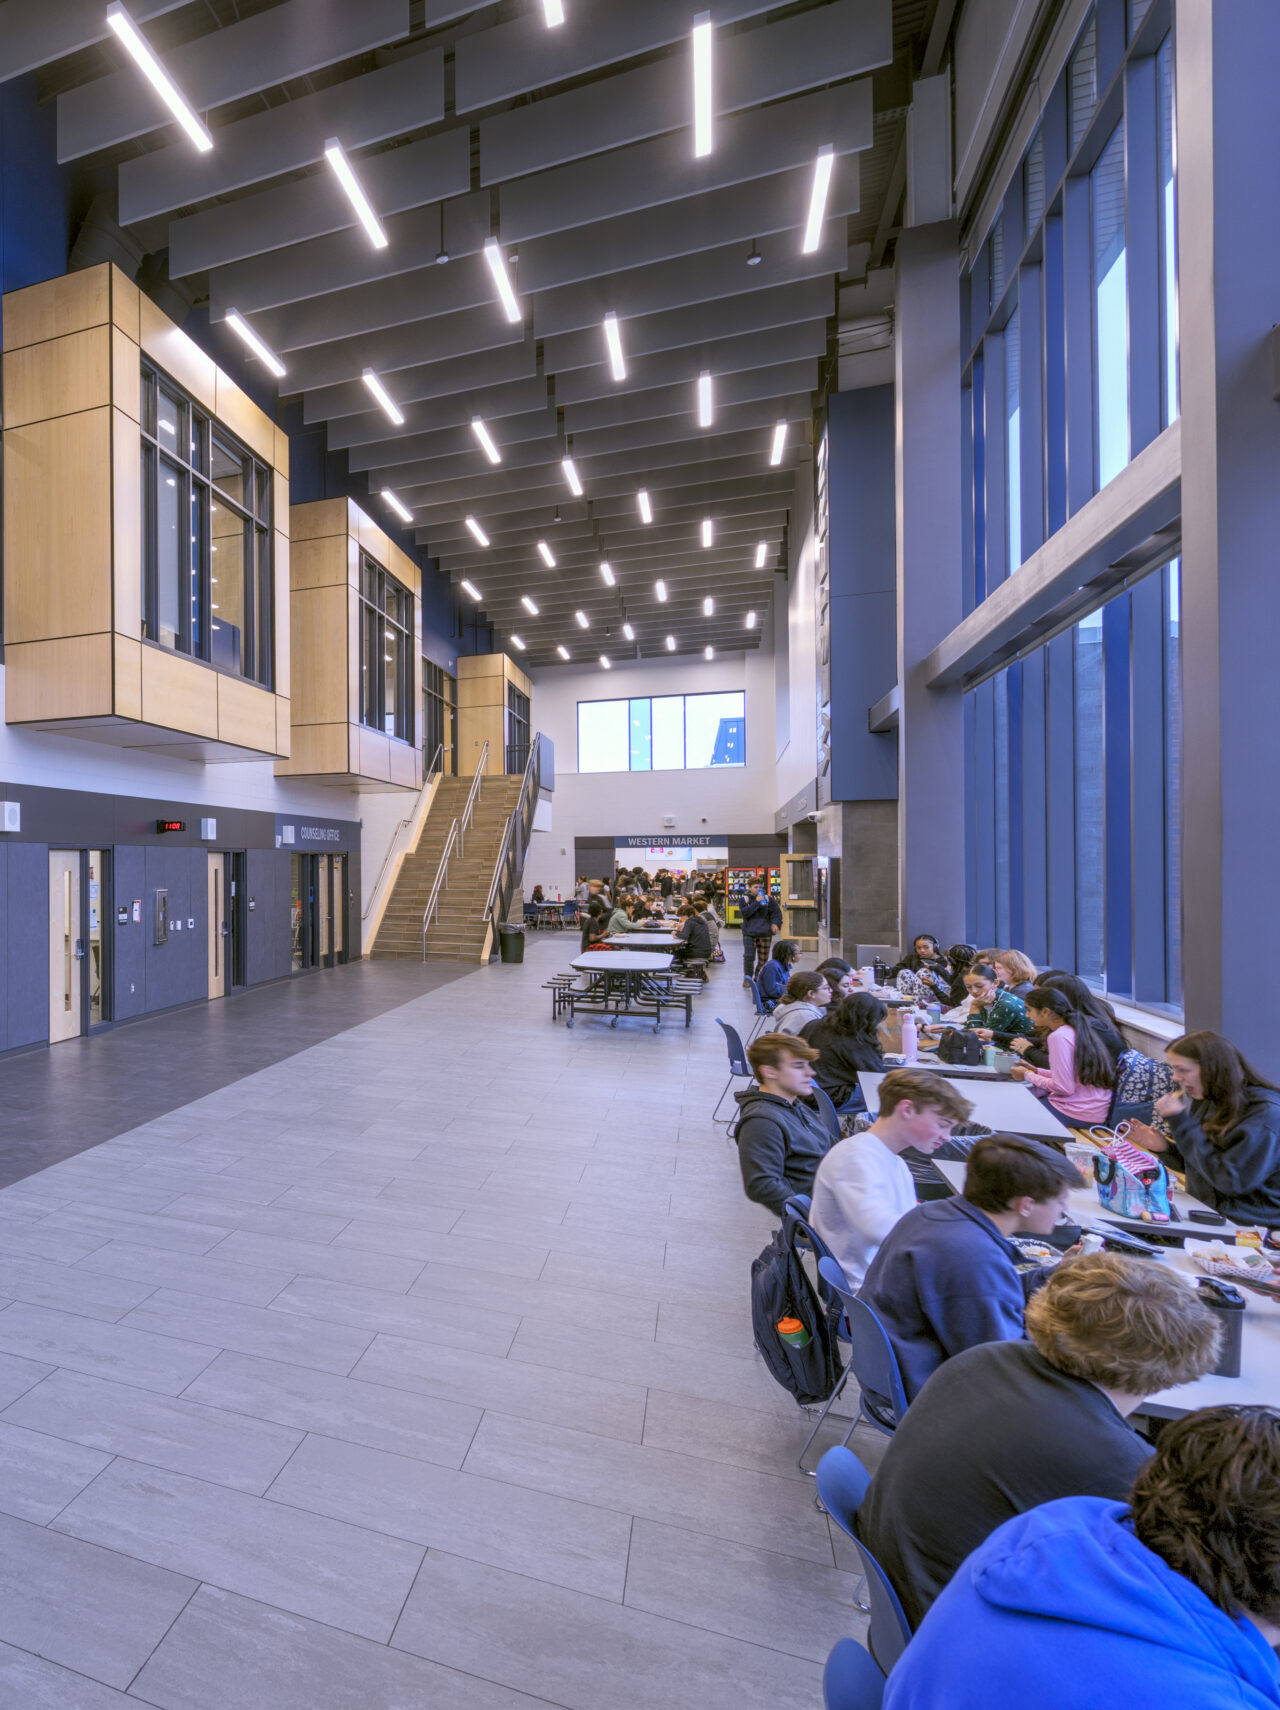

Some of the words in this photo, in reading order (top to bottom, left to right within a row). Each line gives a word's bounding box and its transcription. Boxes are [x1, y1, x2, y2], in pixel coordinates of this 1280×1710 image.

[301, 826, 326, 841] COUNSELING
[327, 829, 340, 841] OFFICE
[628, 837, 670, 846] WESTERN
[672, 837, 711, 845] MARKET
